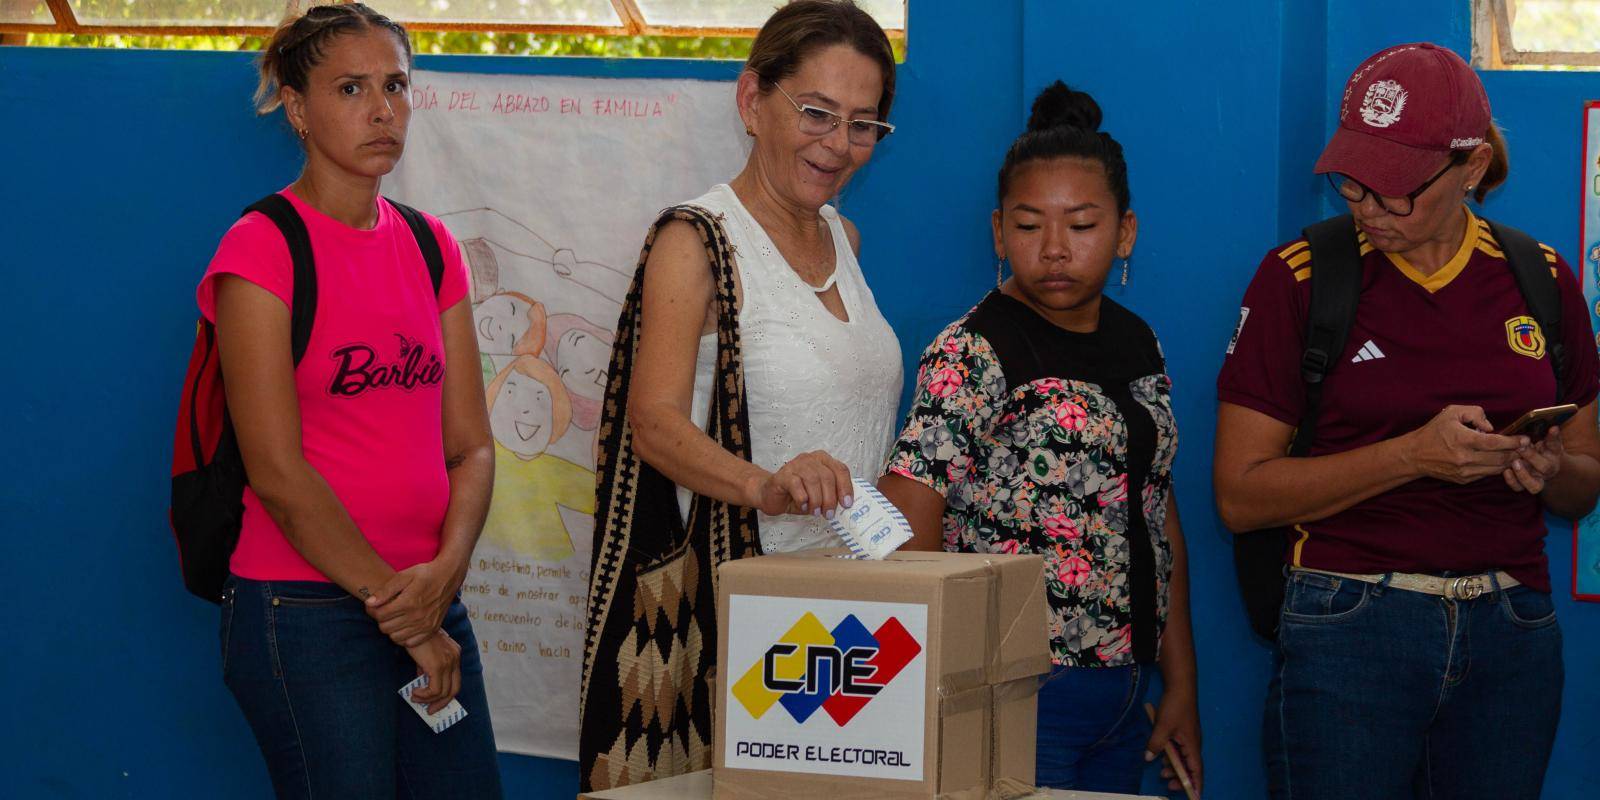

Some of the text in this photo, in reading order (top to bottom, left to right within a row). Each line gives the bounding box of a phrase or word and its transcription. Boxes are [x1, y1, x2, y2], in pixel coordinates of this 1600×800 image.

[412, 84, 438, 110] DÍA
[448, 91, 480, 111] DEL
[492, 93, 549, 114] ABRAZO
[560, 97, 581, 114] EN
[329, 344, 445, 396] Barbie
[498, 584, 509, 597] de
[517, 588, 560, 601] mostrar
[539, 642, 570, 659] hacia
[763, 643, 886, 696] CNE
[736, 741, 911, 767] PODER ELECTORAL
